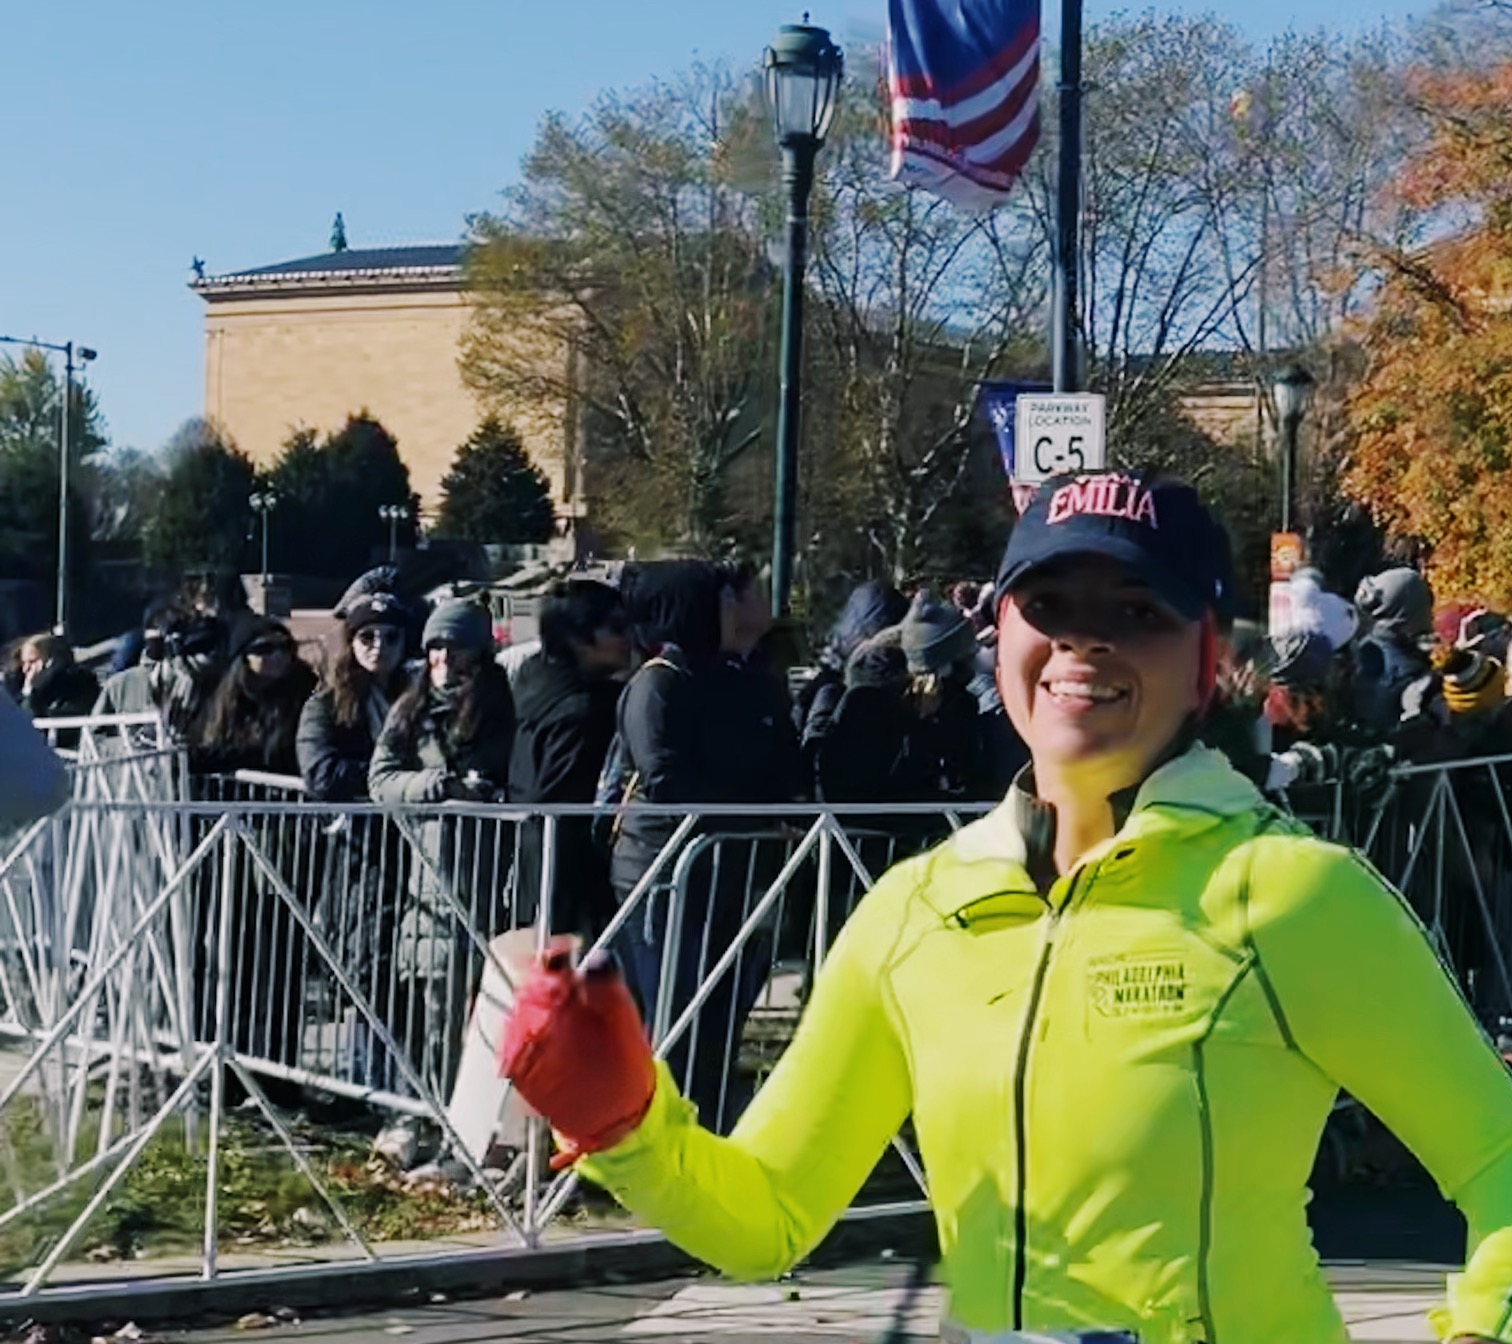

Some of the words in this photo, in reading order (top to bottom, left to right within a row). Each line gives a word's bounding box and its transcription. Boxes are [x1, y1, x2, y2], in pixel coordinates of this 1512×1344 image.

[1029, 414, 1092, 427] LOCATION
[1034, 435, 1086, 475] C-5
[1046, 481, 1158, 530] EMILIA
